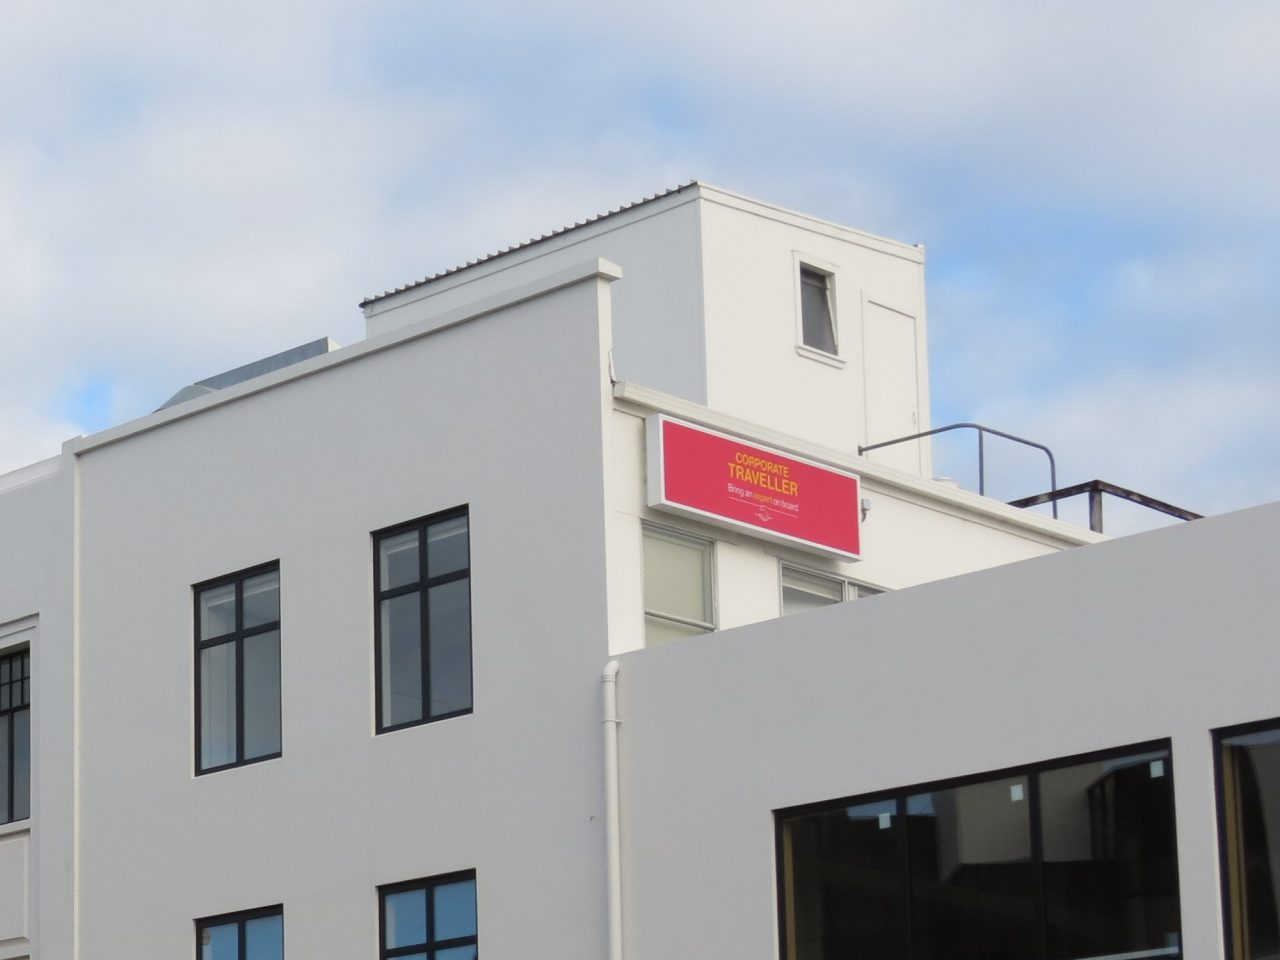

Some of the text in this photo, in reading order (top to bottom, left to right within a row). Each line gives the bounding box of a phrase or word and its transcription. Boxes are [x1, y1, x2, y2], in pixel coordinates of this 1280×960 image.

[727, 462, 799, 498] TRAVELLER
[735, 452, 790, 479] CORPORATE
[727, 483, 745, 498] Bring
[744, 490, 753, 498] an
[773, 498, 782, 506] on
[781, 500, 799, 512] board
